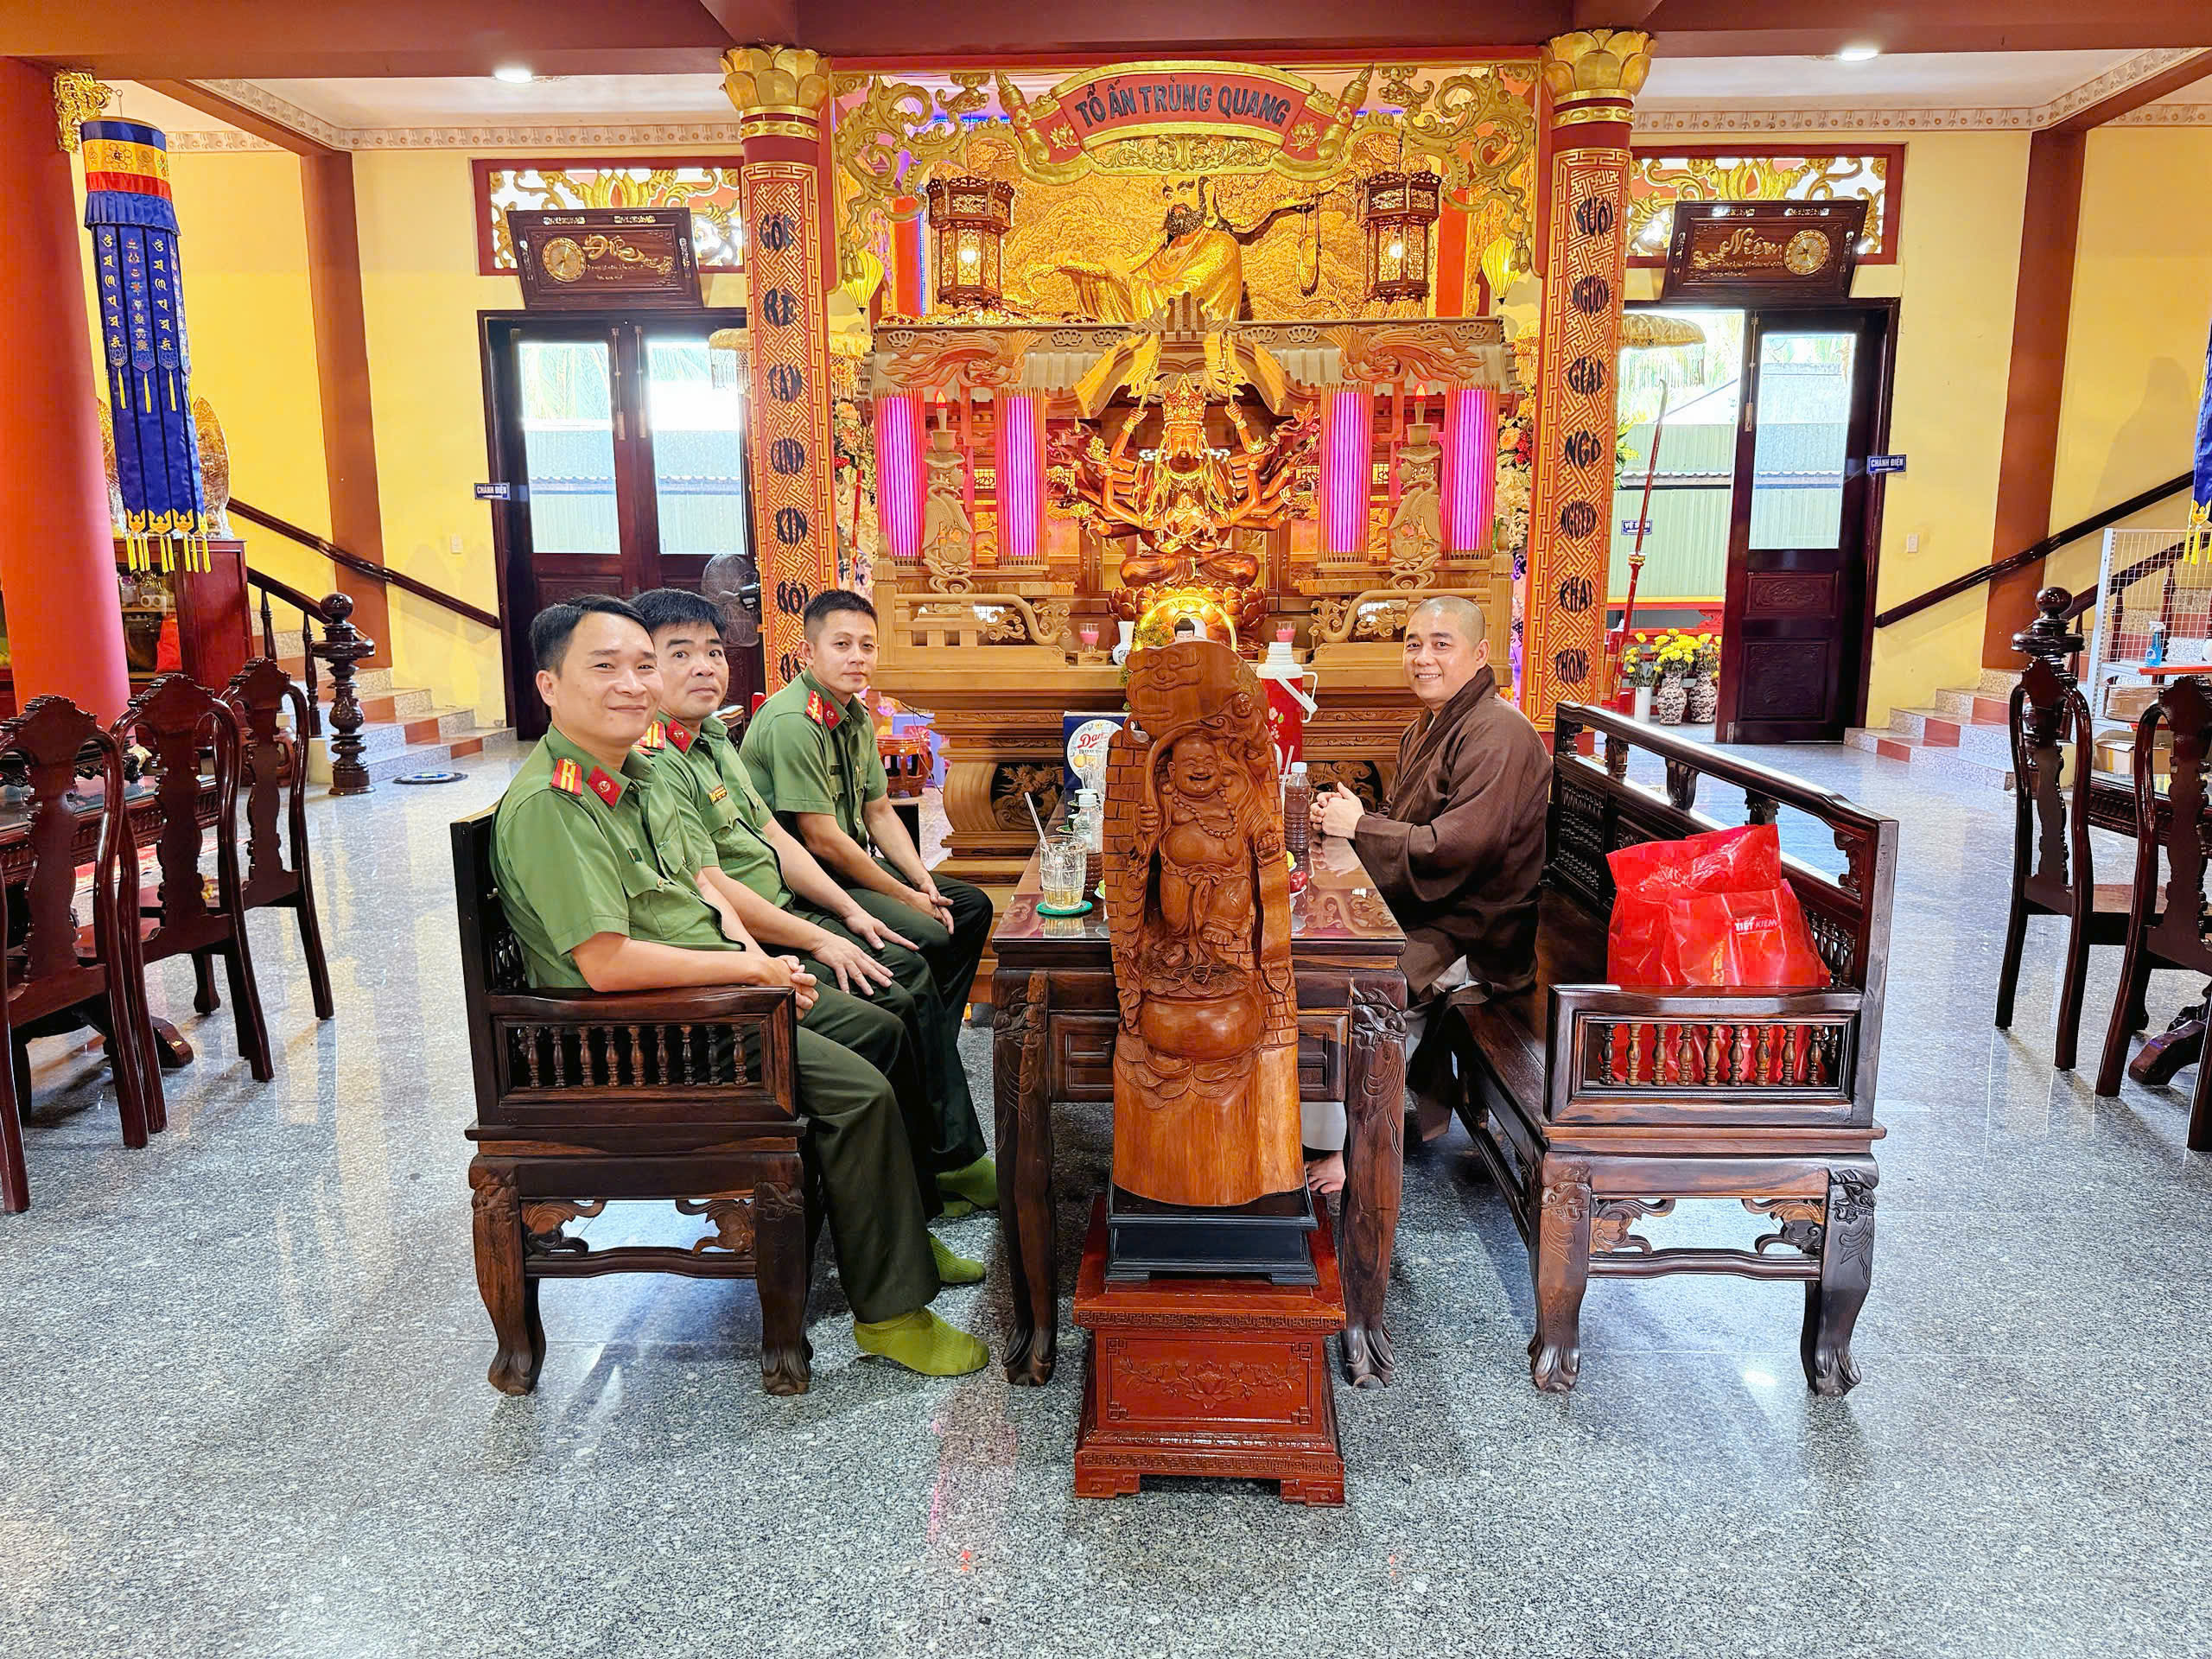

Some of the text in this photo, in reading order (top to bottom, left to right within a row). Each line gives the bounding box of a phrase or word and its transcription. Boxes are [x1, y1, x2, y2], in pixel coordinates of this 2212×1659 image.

[1075, 76, 1291, 128] TỔ ẤN TRÙNG QUANG
[1560, 576, 1593, 613] KHAI
[1555, 648, 1590, 683] THÔNG
